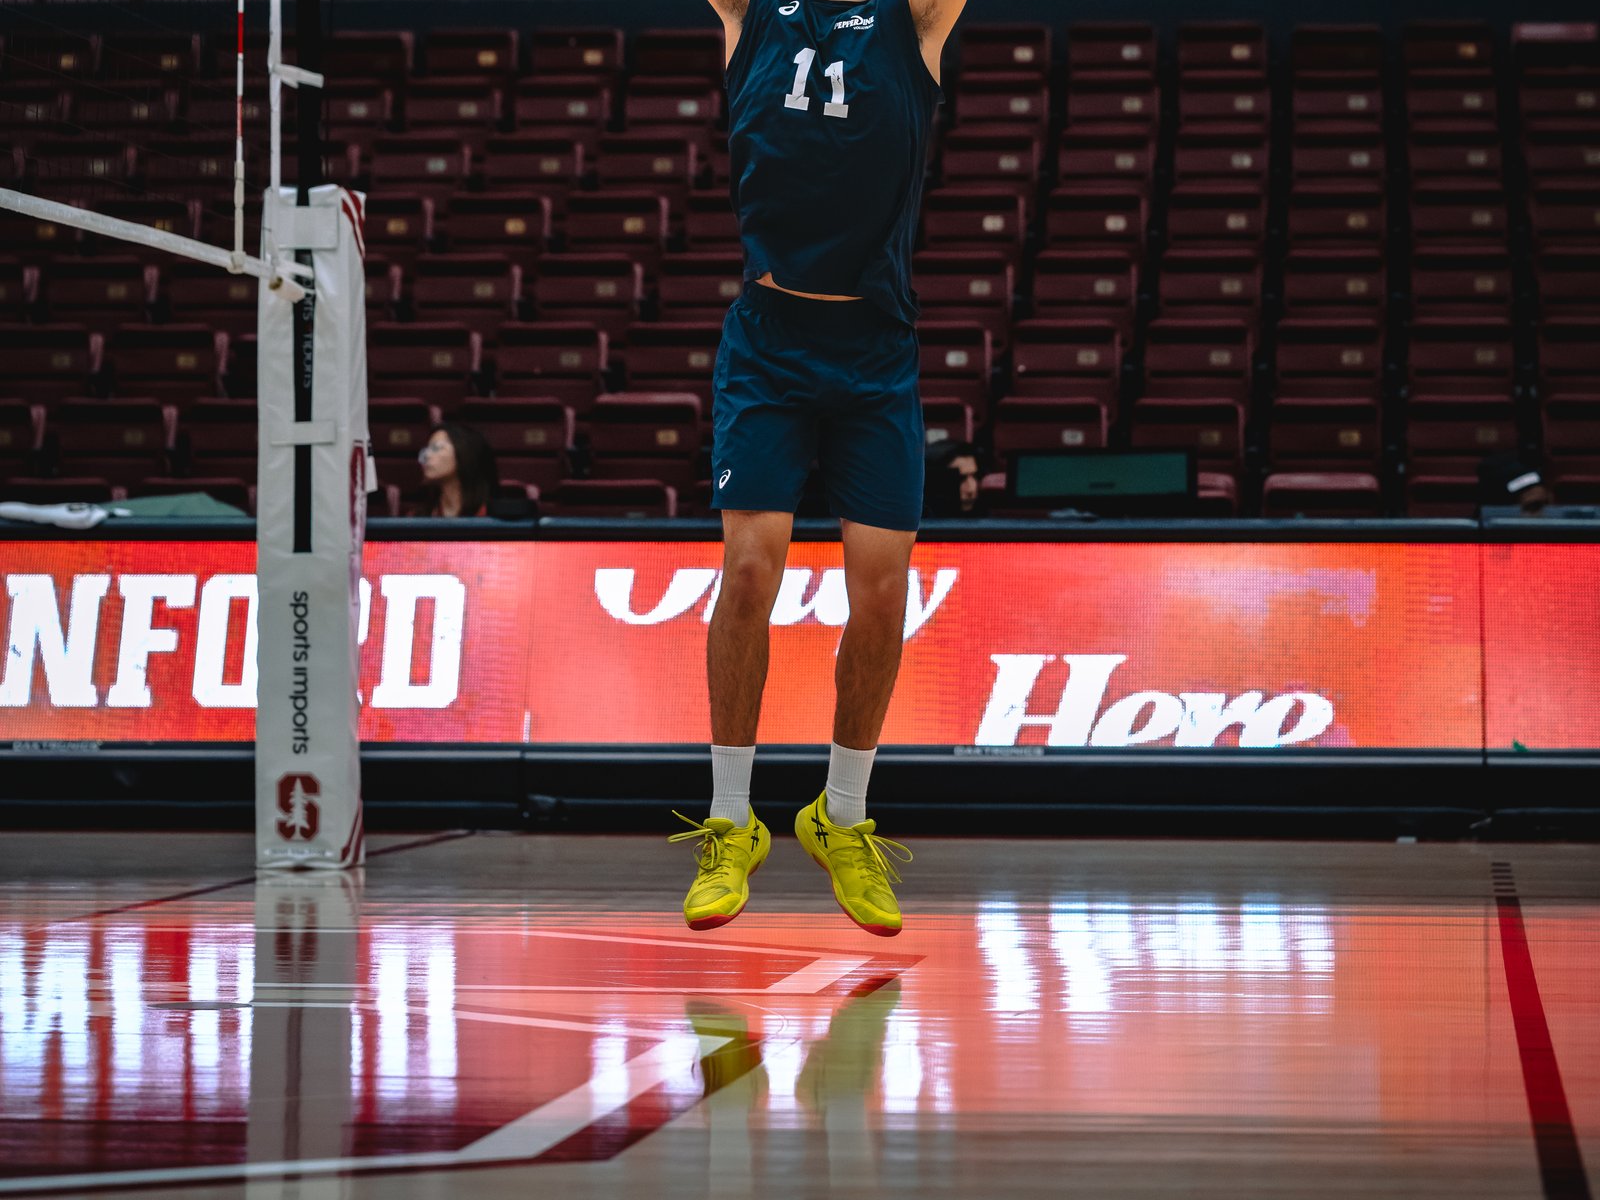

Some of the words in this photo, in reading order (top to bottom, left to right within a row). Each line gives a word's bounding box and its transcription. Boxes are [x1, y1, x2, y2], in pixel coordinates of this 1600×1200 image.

[834, 14, 875, 30] PEPPERDINE
[784, 47, 849, 119] 11
[289, 591, 312, 662] sports
[288, 666, 311, 755] imports
